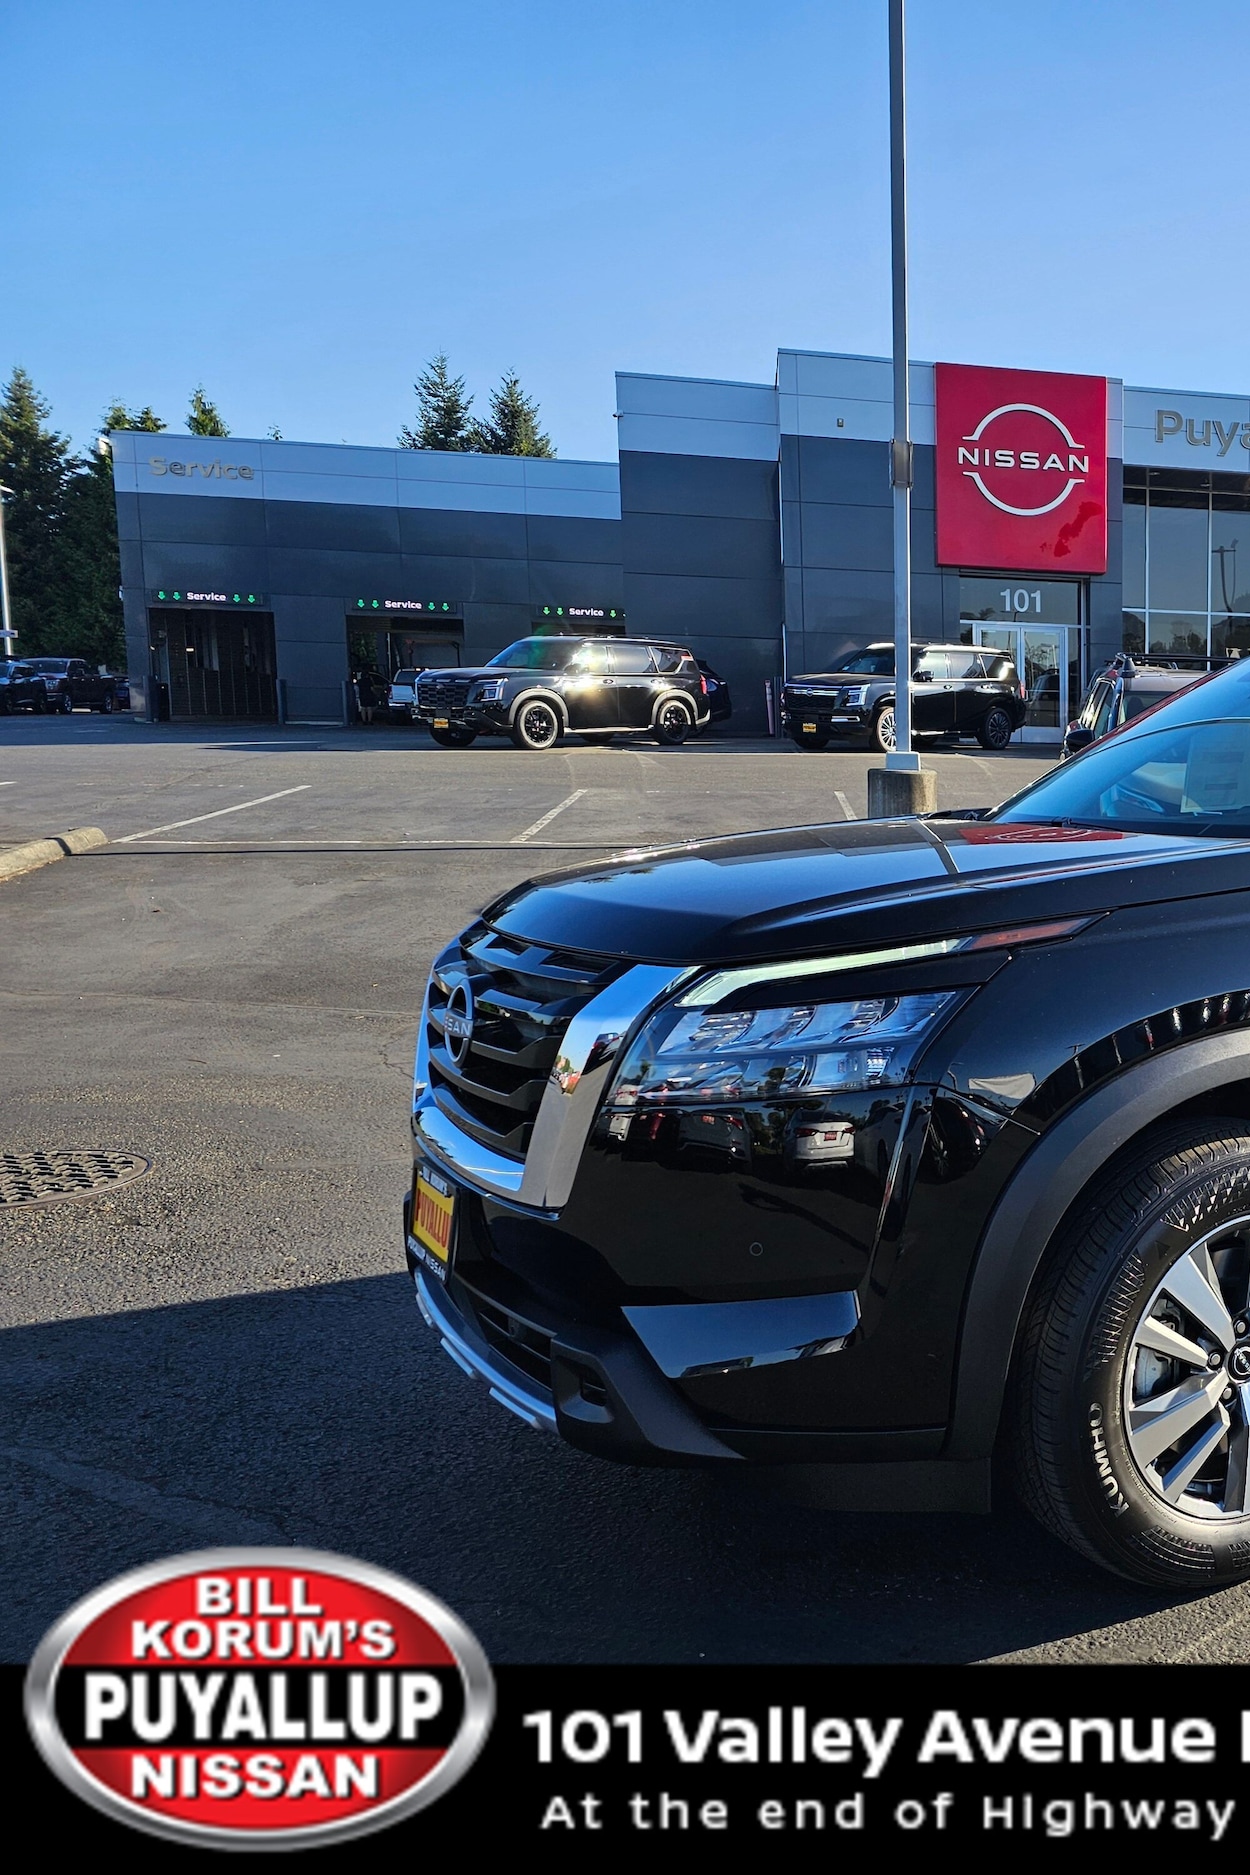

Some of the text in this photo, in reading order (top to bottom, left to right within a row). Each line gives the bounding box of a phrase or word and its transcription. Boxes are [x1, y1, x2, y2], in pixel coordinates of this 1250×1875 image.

[149, 456, 254, 480] Service
[958, 447, 1089, 473] NISSAN
[186, 592, 227, 602] Service
[384, 600, 422, 610] Service
[1000, 588, 1041, 613] 101
[568, 607, 604, 616] Service
[1087, 1402, 1130, 1518] KUMHO
